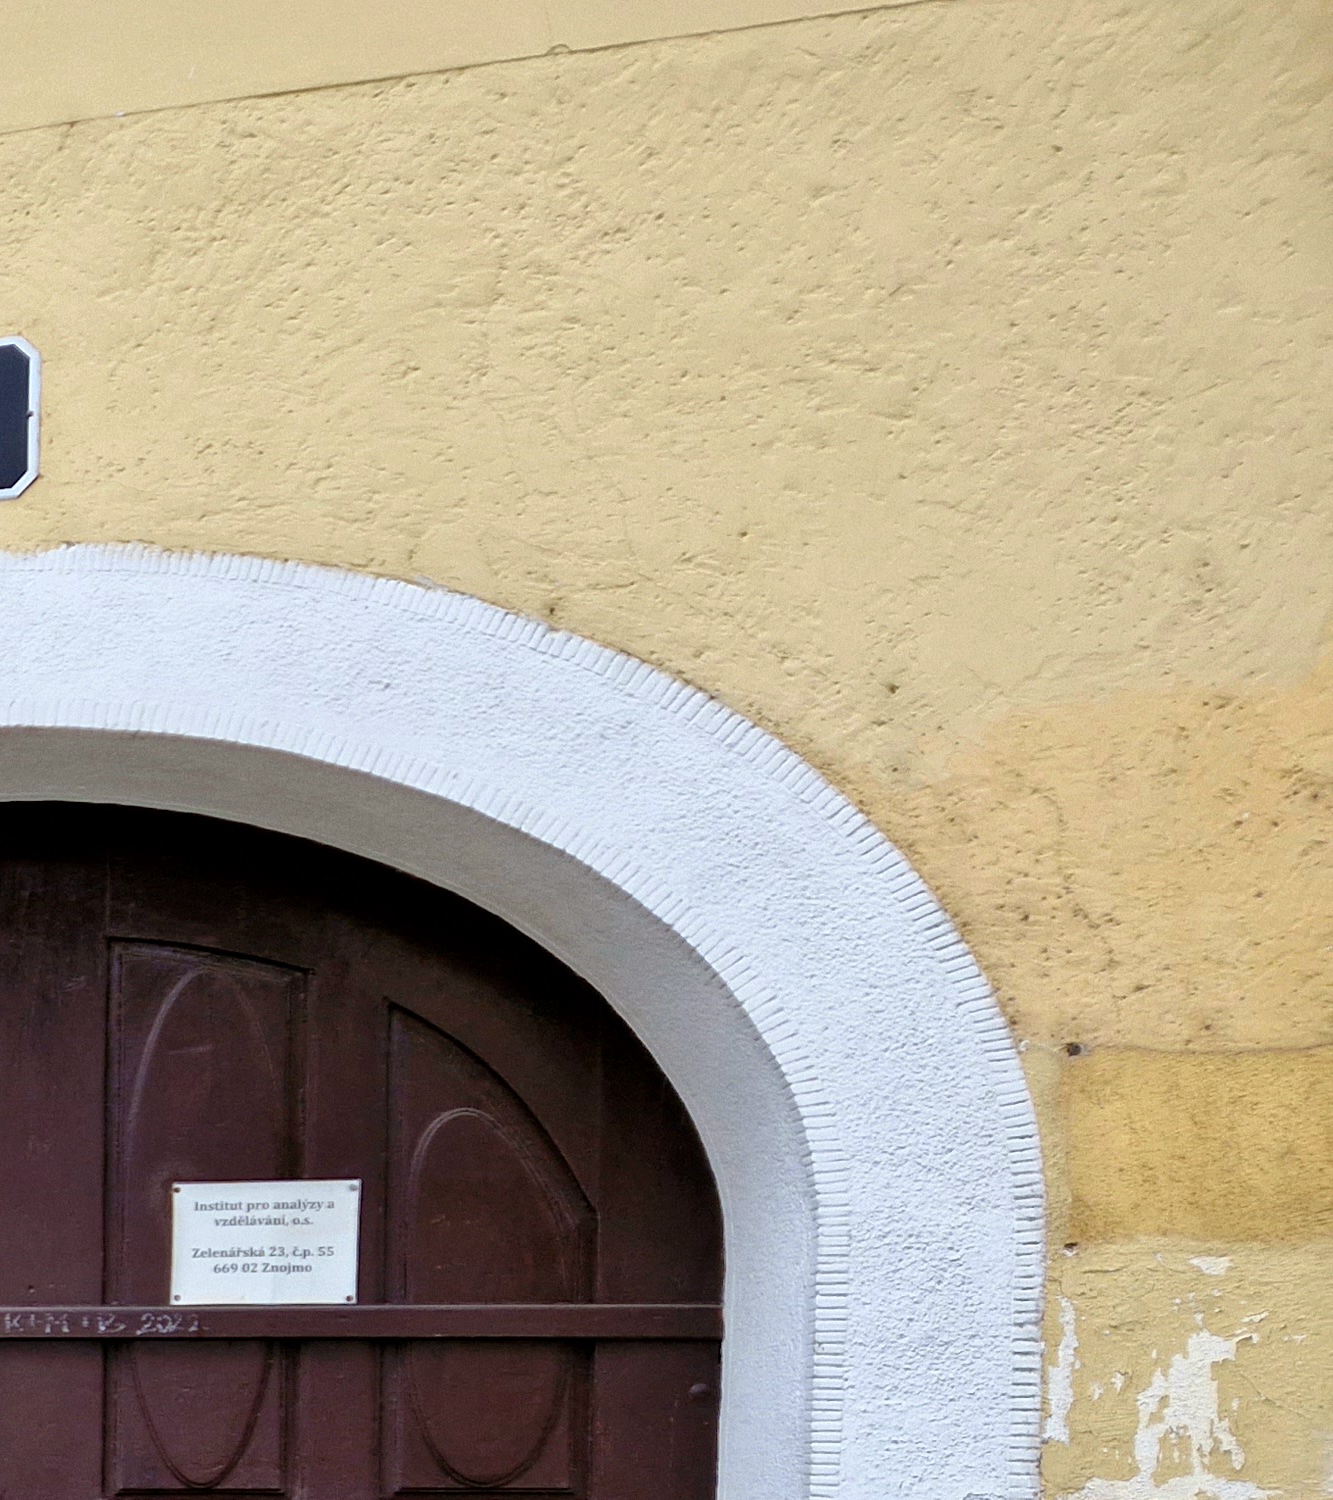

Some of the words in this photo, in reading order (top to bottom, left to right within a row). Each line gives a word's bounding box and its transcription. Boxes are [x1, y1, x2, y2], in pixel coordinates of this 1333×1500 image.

[194, 1201, 243, 1212] Institut
[246, 1201, 270, 1213] pro
[273, 1199, 324, 1212] analýzy
[327, 1200, 335, 1209] a
[214, 1214, 289, 1227] vzdělávání,
[292, 1216, 314, 1226] o.s.
[192, 1247, 265, 1259] Zelenářská
[269, 1246, 289, 1258] 23,
[292, 1246, 314, 1259] č.p.
[318, 1246, 335, 1257] 55
[213, 1263, 238, 1274] 669
[242, 1262, 258, 1273] 02
[262, 1262, 313, 1275] Znojmo
